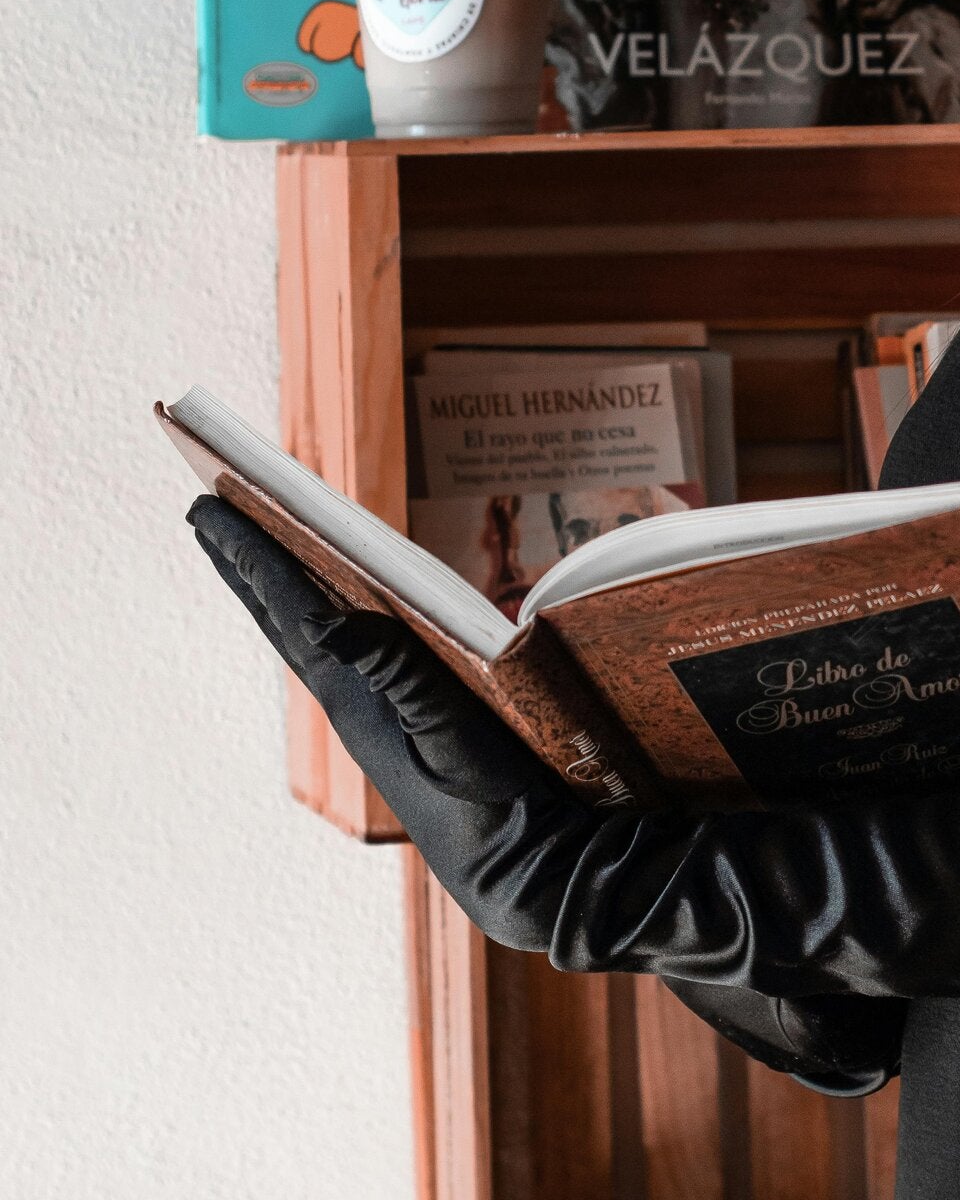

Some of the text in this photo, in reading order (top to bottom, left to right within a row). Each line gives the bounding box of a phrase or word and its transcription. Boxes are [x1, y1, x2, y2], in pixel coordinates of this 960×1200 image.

[586, 22, 926, 84] VELÁZQUEZ
[430, 382, 663, 419] MIGUEL HERNÁNDEZ
[463, 425, 636, 449] El rayo que no cesa
[865, 583, 897, 597] POR
[667, 583, 944, 656] JESUS MENENDEZ PELAEZ
[756, 646, 912, 697] Libro de
[736, 697, 855, 735] Buen
